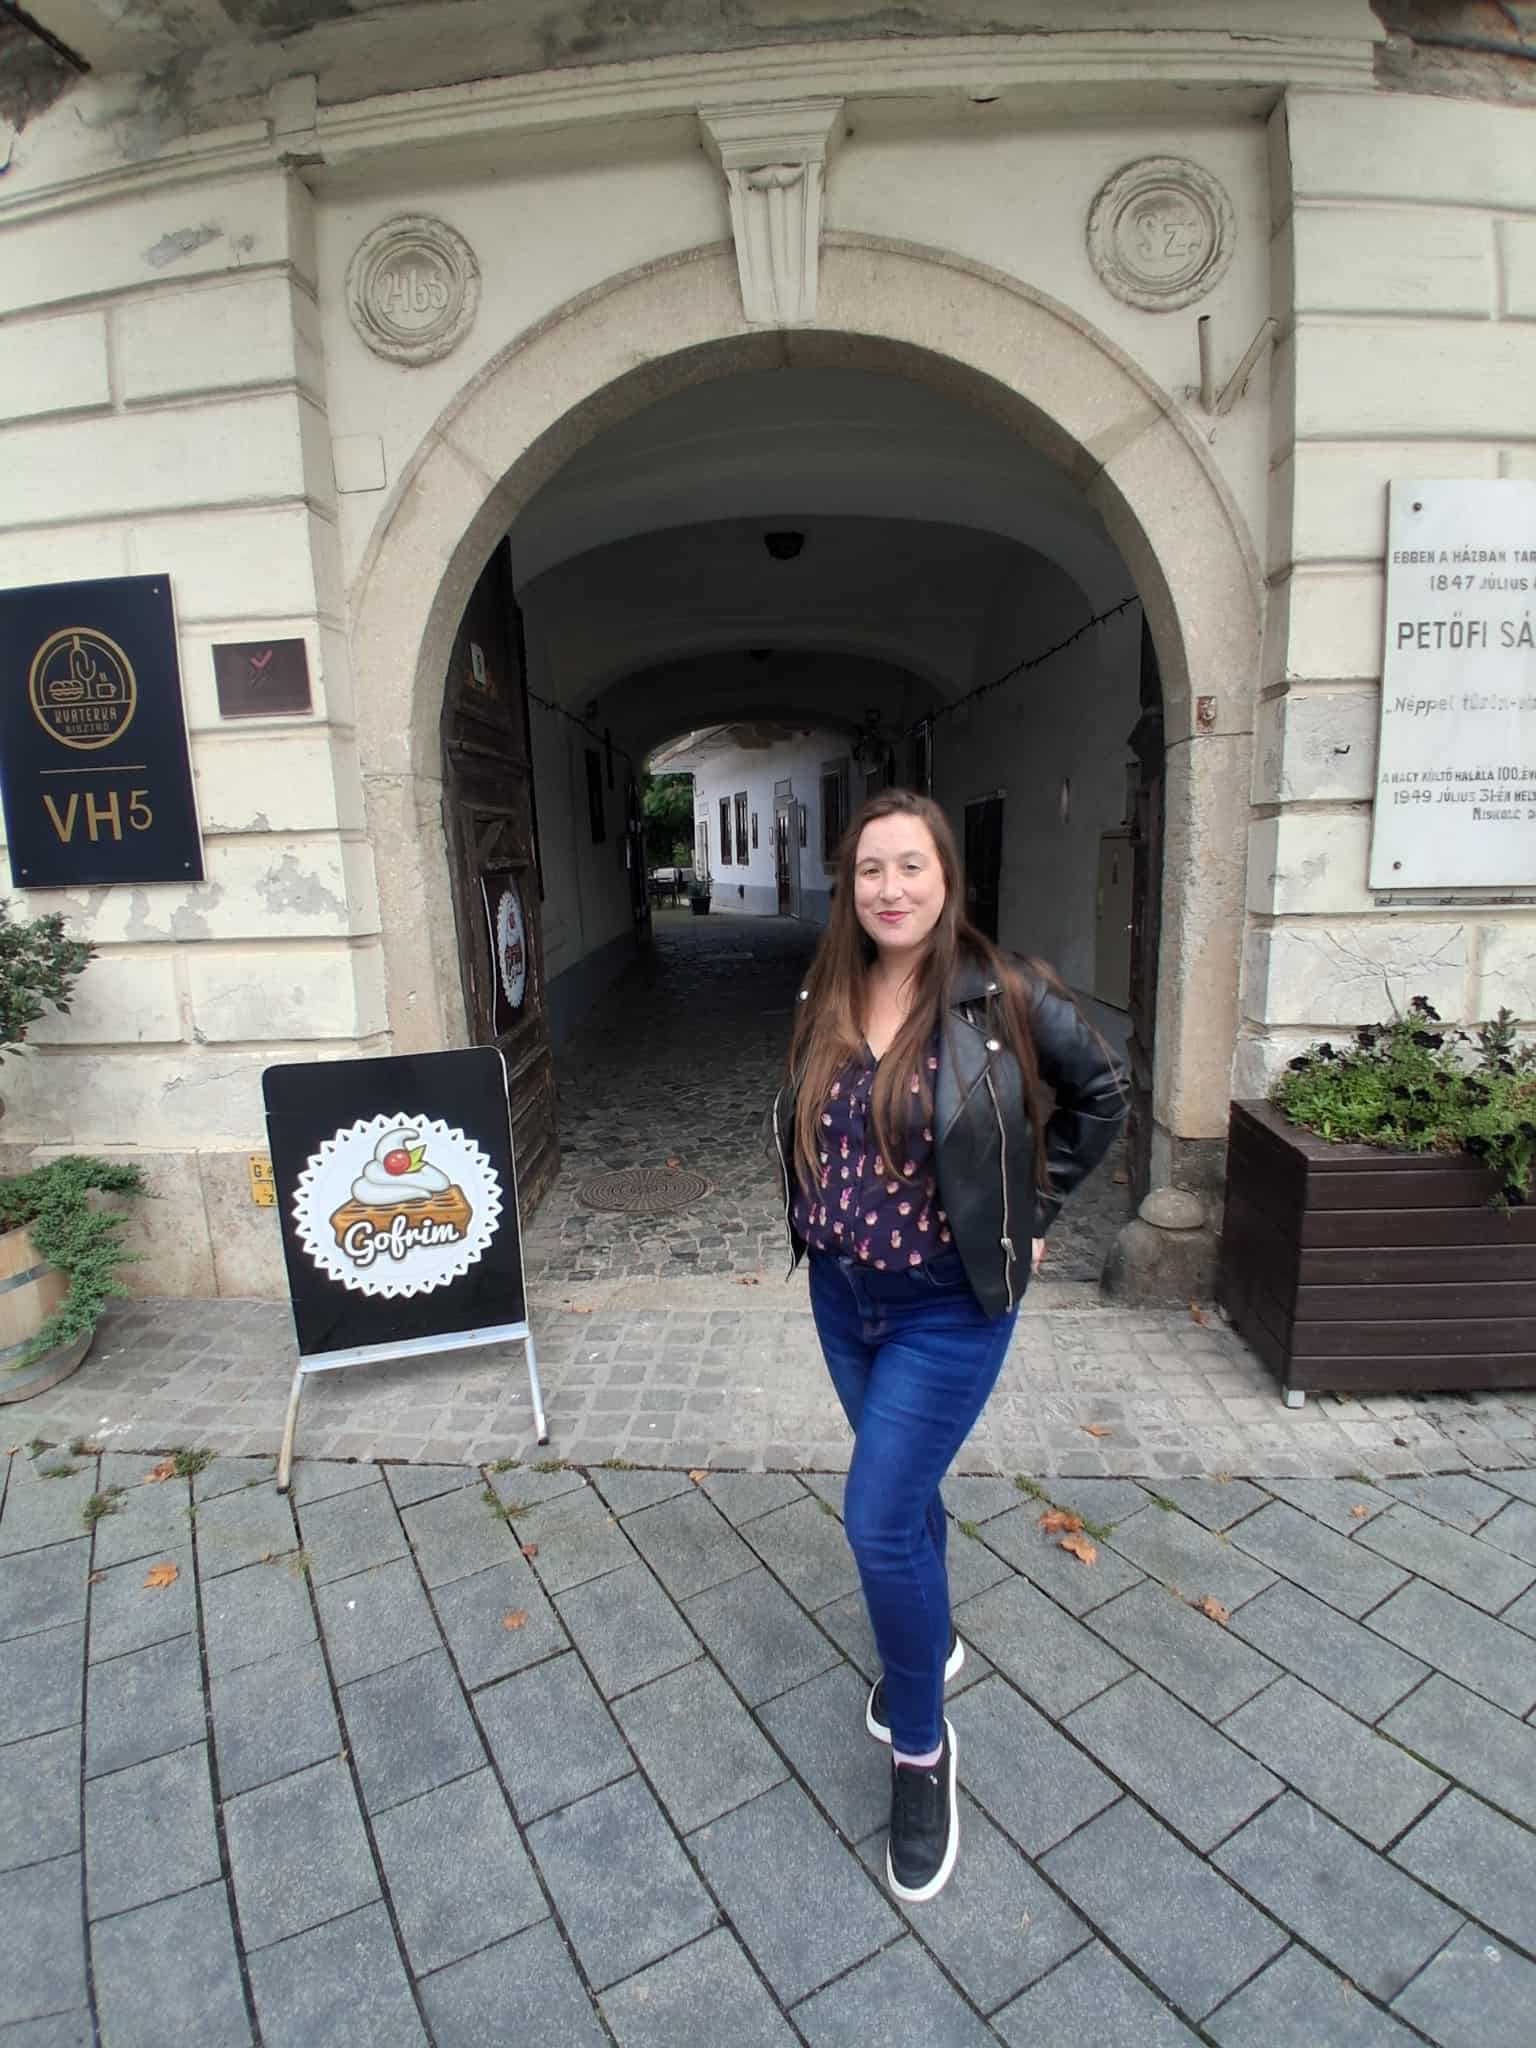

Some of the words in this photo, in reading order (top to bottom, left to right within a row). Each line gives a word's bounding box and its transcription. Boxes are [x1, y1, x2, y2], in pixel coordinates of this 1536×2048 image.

[1393, 551, 1435, 564] EBBEN
[1440, 551, 1449, 563] A
[1453, 545, 1506, 563] HÁZBAN
[1430, 575, 1475, 590] 1847
[1480, 571, 1528, 590] JÚLIUS
[1398, 610, 1487, 650] PETŐFI
[1501, 610, 1536, 648] SÁ
[55, 706, 117, 723] KVATERKA
[1394, 789, 1432, 804] 1949
[343, 1213, 460, 1266] Gofrim
